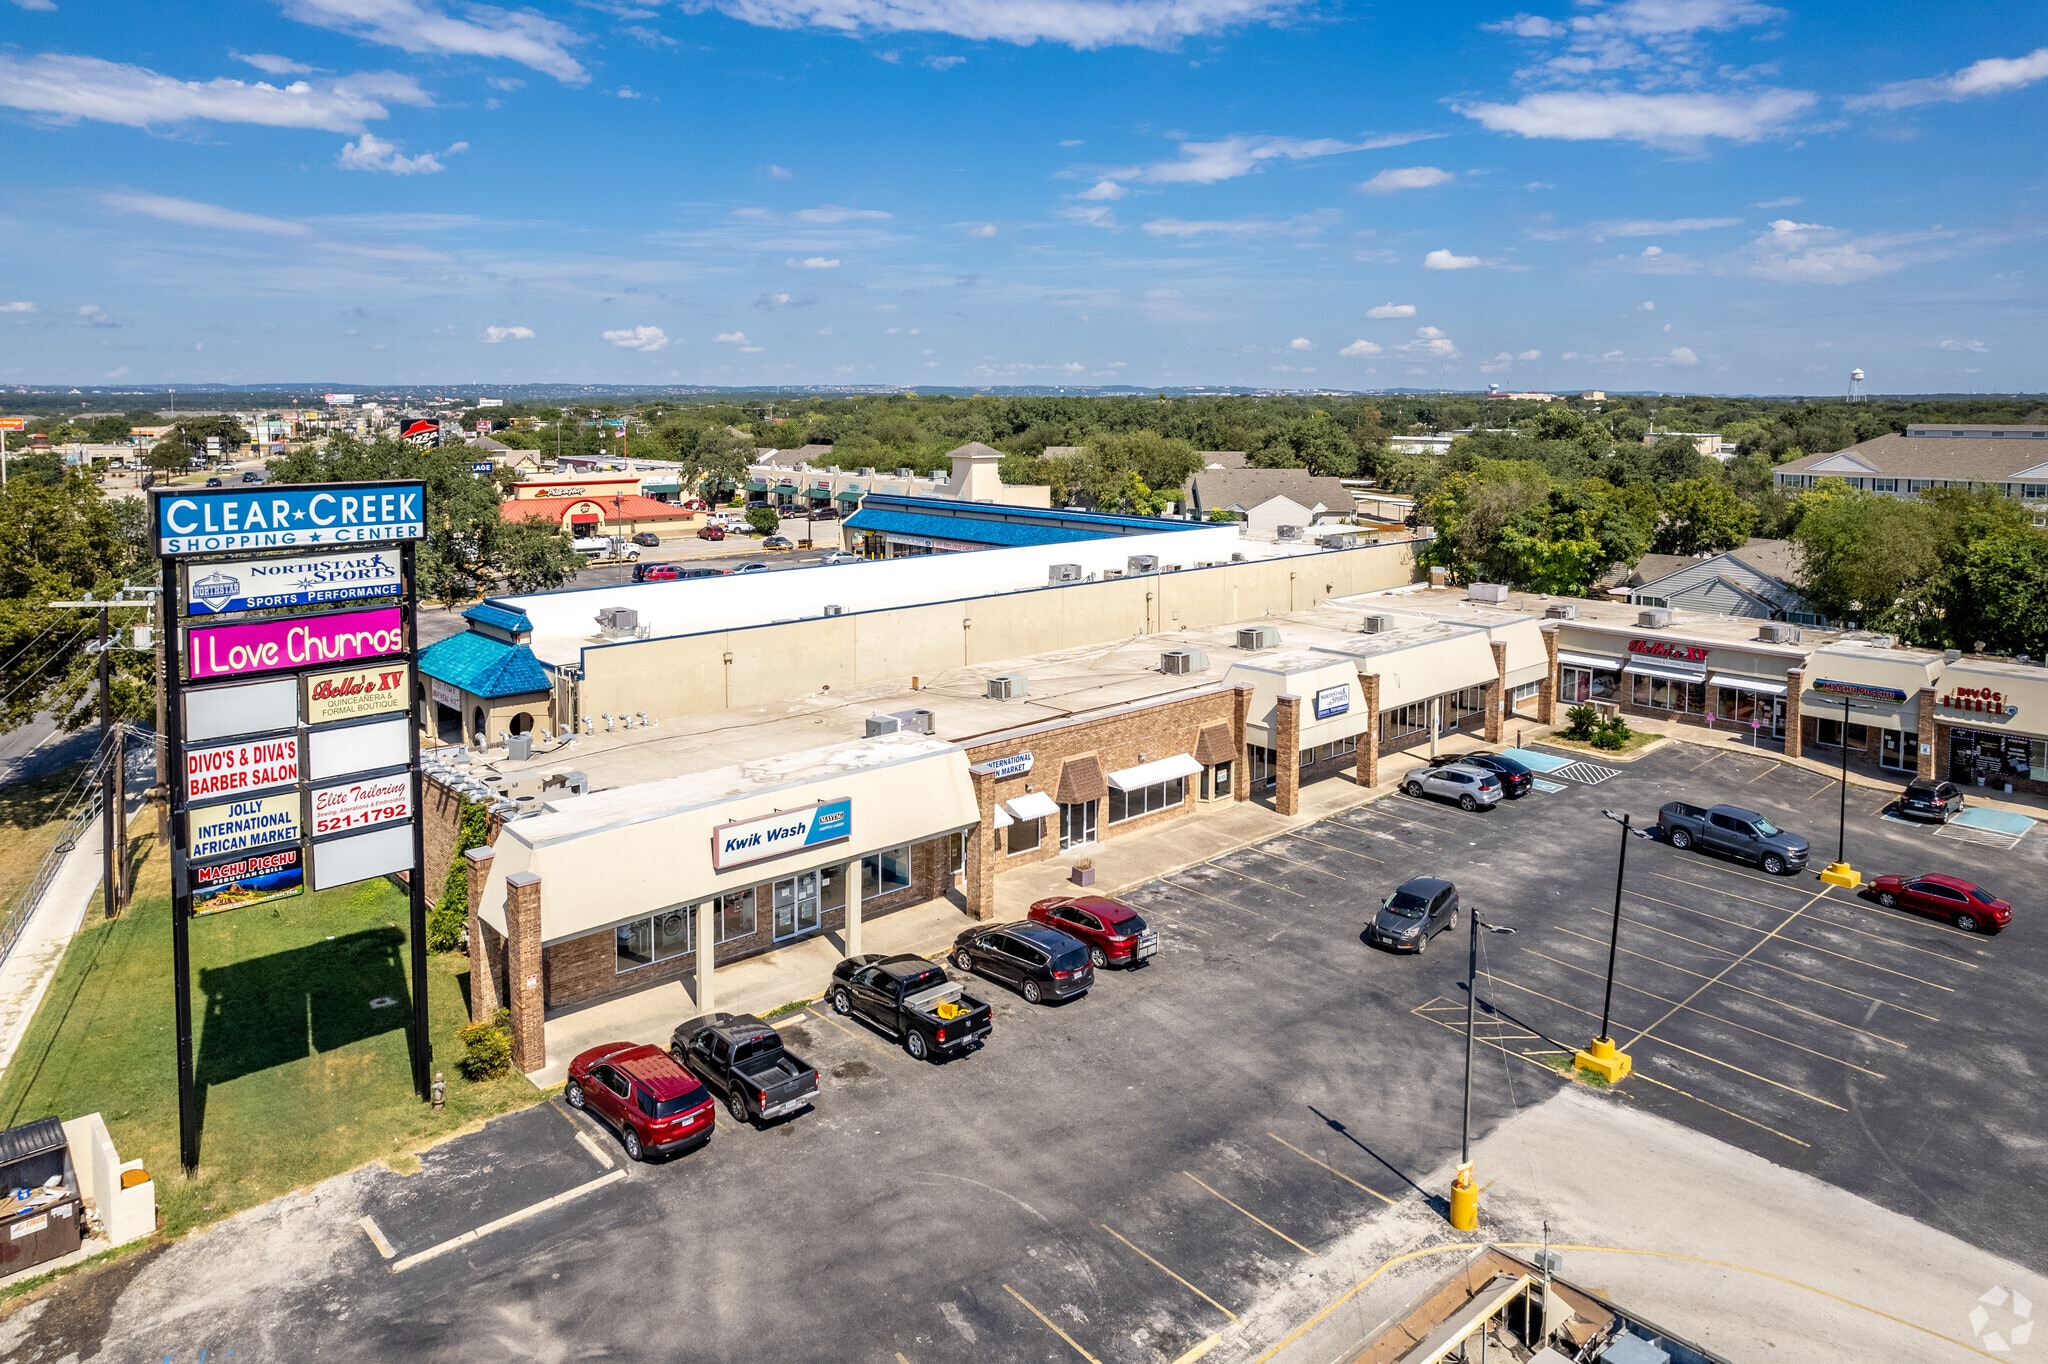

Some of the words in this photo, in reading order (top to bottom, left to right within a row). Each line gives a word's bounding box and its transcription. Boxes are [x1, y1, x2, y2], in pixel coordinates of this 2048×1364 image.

[167, 499, 290, 534] CLEAR
[309, 493, 417, 526] CREEK
[168, 532, 297, 553] SHOPPING
[335, 525, 417, 542] CENTER
[313, 566, 395, 583] SPORTS
[193, 583, 239, 597] NORTHSTAR
[246, 594, 298, 608] SPORTS
[308, 585, 397, 601] PERFORMANCE
[193, 637, 200, 675] I
[209, 635, 279, 673] Love
[287, 625, 402, 663] Churros
[1628, 640, 1684, 658] Bella's
[1685, 646, 1710, 661] XV
[312, 675, 376, 701] Bella's
[377, 671, 404, 691] XV
[1823, 682, 1857, 694] MACHU
[1859, 687, 1895, 699] PICCHU
[322, 706, 356, 716] FORMAL
[357, 699, 398, 711] BOUTIQUE
[327, 693, 386, 708] QUINCEAÑERA
[1943, 695, 2002, 715] BARBER
[189, 750, 234, 775] DIVO'S
[239, 748, 249, 766] &
[253, 741, 296, 764] DIVA'S
[1001, 763, 1025, 775] MARKET
[190, 771, 248, 796] BARBER
[252, 763, 297, 785] SALON
[316, 792, 348, 810] Elite
[350, 782, 406, 802] Tailoring
[375, 796, 406, 807] Embroidery
[228, 800, 263, 818] JOLLY
[316, 804, 407, 832] 521-1792
[198, 811, 292, 839] INTERNATIONAL
[725, 832, 762, 853] Kwik
[766, 822, 806, 842] Wash
[193, 835, 247, 856] AFRICAN
[250, 826, 298, 846] MARKET
[199, 861, 247, 882] MACHU
[249, 850, 296, 872] PICCHU
[213, 871, 257, 885] PERUVIAN
[258, 866, 284, 875] GRILL
